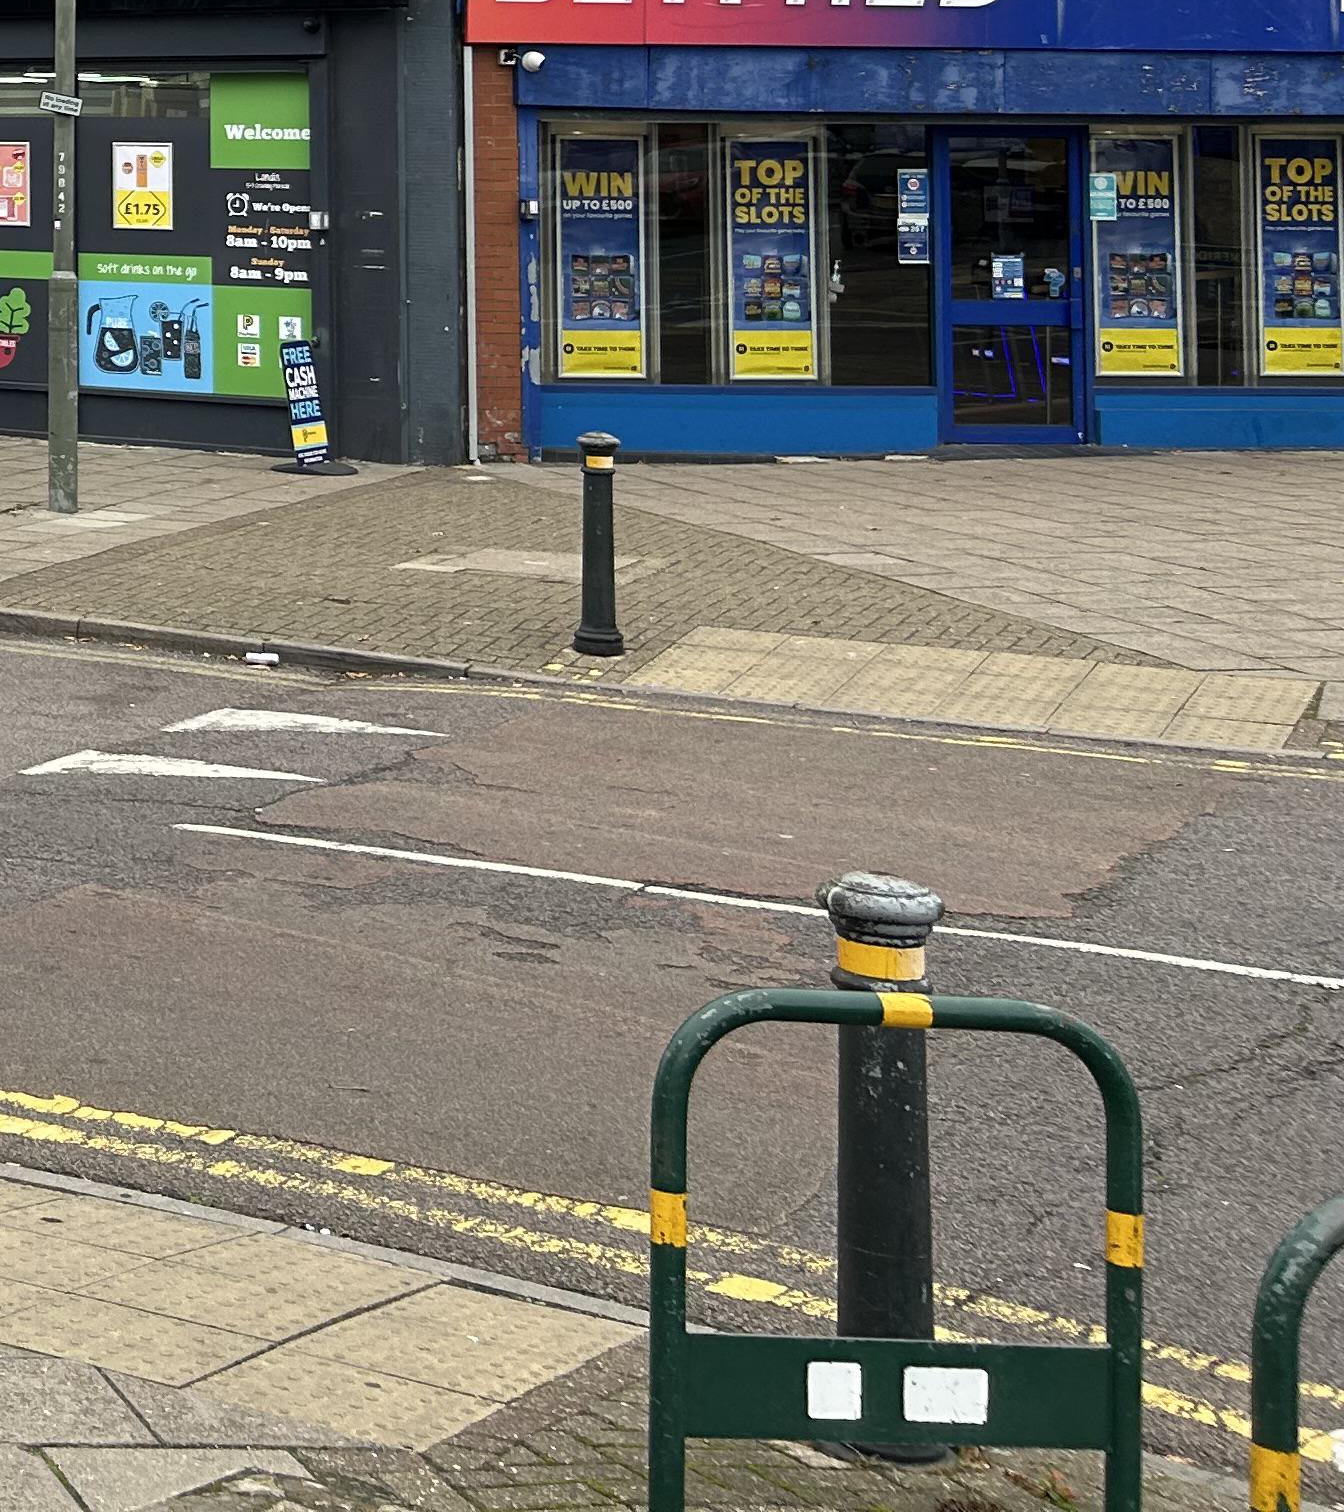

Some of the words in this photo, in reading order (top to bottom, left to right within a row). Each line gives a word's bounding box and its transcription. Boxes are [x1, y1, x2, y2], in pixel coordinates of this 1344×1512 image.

[224, 124, 310, 140] Welcome
[734, 159, 804, 186] TOP
[1264, 157, 1332, 184] TOP
[562, 171, 632, 197] WIN
[734, 188, 763, 204] OF
[766, 188, 805, 204] THE
[1265, 185, 1293, 202] OF
[1296, 186, 1333, 202] THE
[124, 203, 160, 215] £1.75
[252, 202, 280, 212] We're
[562, 199, 580, 210] UP
[582, 199, 600, 210] TO
[602, 199, 632, 211] £500
[1118, 199, 1136, 209] TO
[1138, 198, 1169, 209] £500
[1265, 203, 1334, 221] SLOTS
[734, 206, 805, 224] SLOTS
[228, 225, 263, 235] Monday
[269, 226, 310, 237] Saturday
[226, 234, 258, 248] 8am
[270, 236, 312, 251] 10pm
[251, 257, 285, 267] Sunday
[120, 263, 150, 275] drinks
[152, 267, 163, 275] on
[166, 265, 183, 276] the
[185, 267, 197, 281] go
[230, 266, 262, 279] 8am
[274, 268, 308, 283] 9pm
[282, 345, 312, 365] FREE
[285, 365, 316, 388] CASH
[288, 385, 320, 401] MACHINE
[290, 401, 322, 420] HERE
